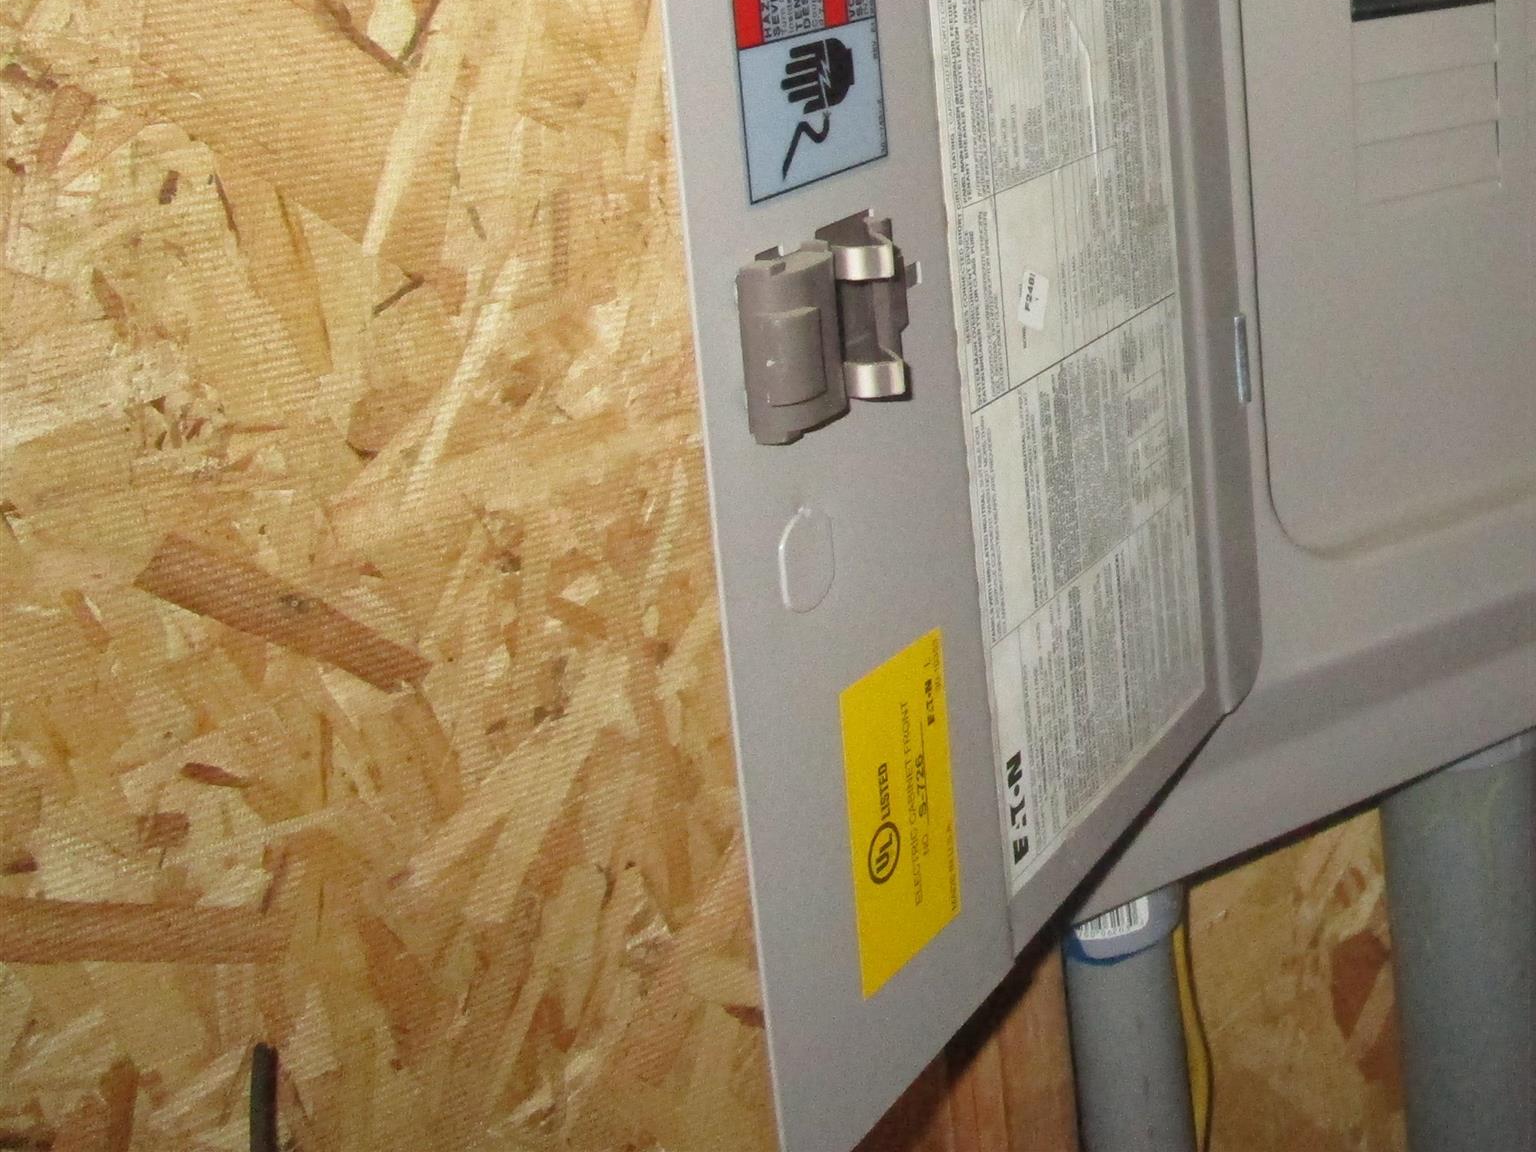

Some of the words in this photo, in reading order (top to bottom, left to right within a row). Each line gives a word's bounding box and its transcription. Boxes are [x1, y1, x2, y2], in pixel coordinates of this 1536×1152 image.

[780, 7, 788, 34] Turn
[900, 699, 911, 755] FRONT
[877, 760, 890, 821] LISTED
[904, 756, 916, 827] CABINET
[914, 753, 926, 818] S-726
[1005, 749, 1028, 866] EATON
[909, 827, 922, 907] ELECTRIC
